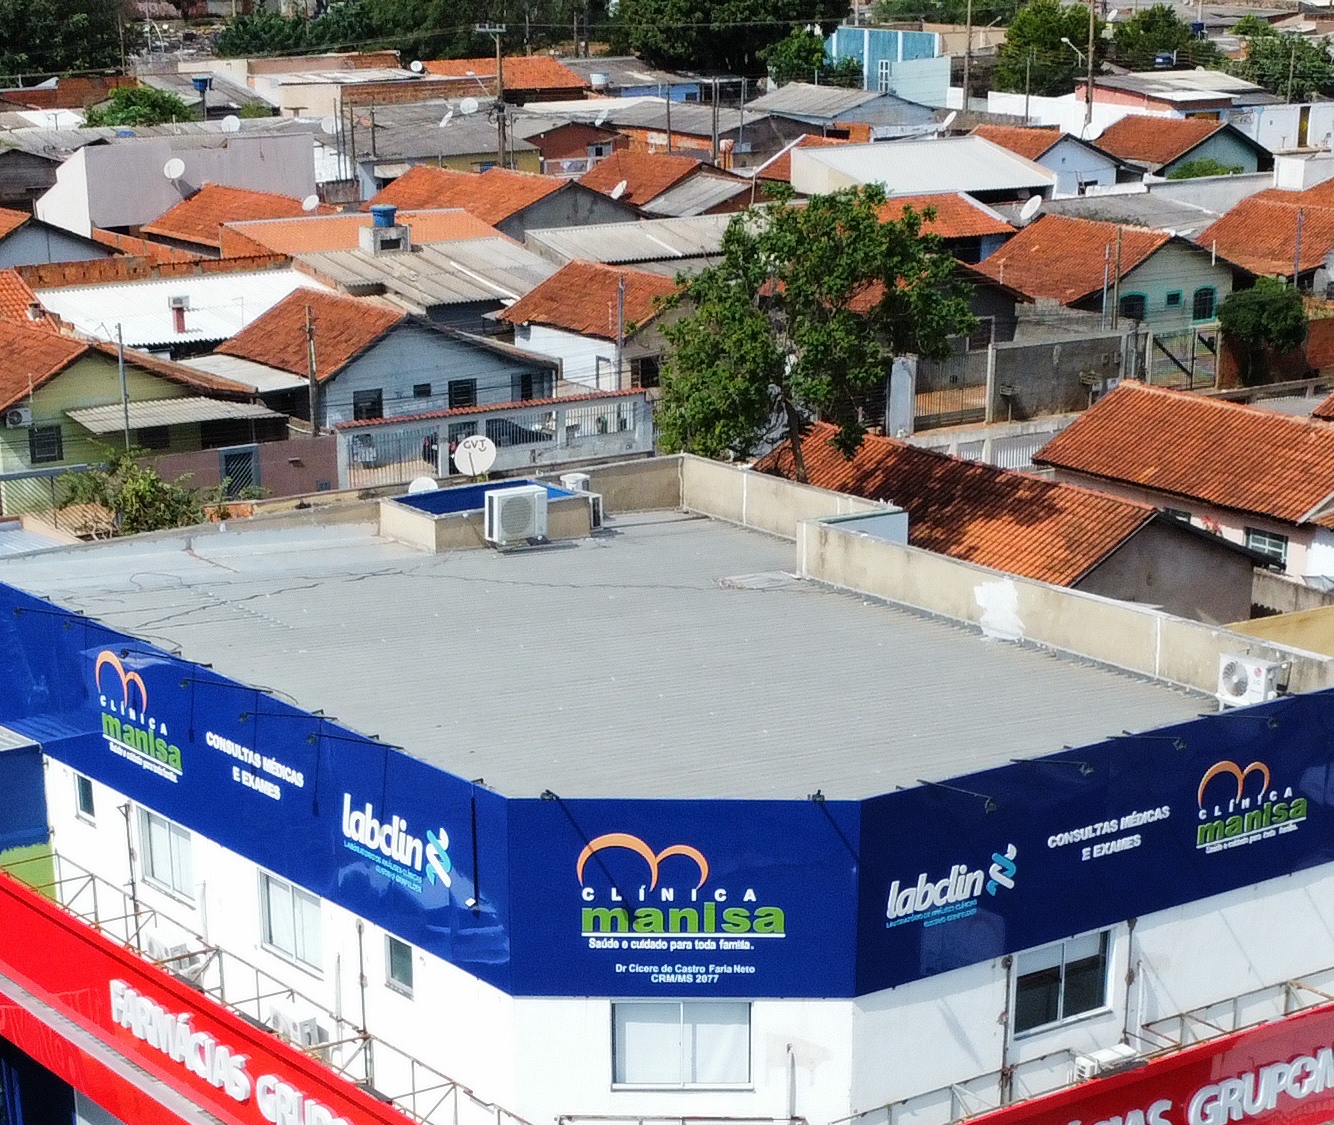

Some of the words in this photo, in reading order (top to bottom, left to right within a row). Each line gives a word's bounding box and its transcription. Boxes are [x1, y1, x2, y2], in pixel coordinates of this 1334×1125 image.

[463, 439, 486, 449] GVT
[99, 694, 168, 735] CLÍNICA
[102, 712, 183, 771] manisa
[205, 731, 262, 769] CONSULTAS
[262, 757, 305, 788] MÉDICAS
[232, 765, 242, 782] E
[241, 769, 281, 800] EXAMES
[1196, 797, 1308, 845] manisa
[1198, 787, 1293, 820] CLÍNICA
[342, 792, 424, 871] labclin
[1048, 819, 1118, 849] CONSULTAS
[1120, 804, 1170, 831] MÉDICAS
[1081, 848, 1091, 861] E
[1092, 834, 1142, 858] EXAMES
[582, 884, 757, 902] CLÍNICA
[886, 864, 984, 919] labclin
[581, 902, 786, 933] manisa
[588, 937, 619, 950] Saúde
[631, 938, 668, 950] cuidado
[670, 941, 692, 952] para
[694, 939, 717, 950] toda
[615, 964, 627, 974] Dr
[661, 964, 673, 974] de
[675, 964, 706, 974] Castro
[708, 964, 732, 974] Faria
[733, 964, 756, 974] Neto
[651, 973, 693, 984] CRM/MS
[695, 973, 719, 984] 2077
[109, 979, 251, 1102] FARMÁCIAS
